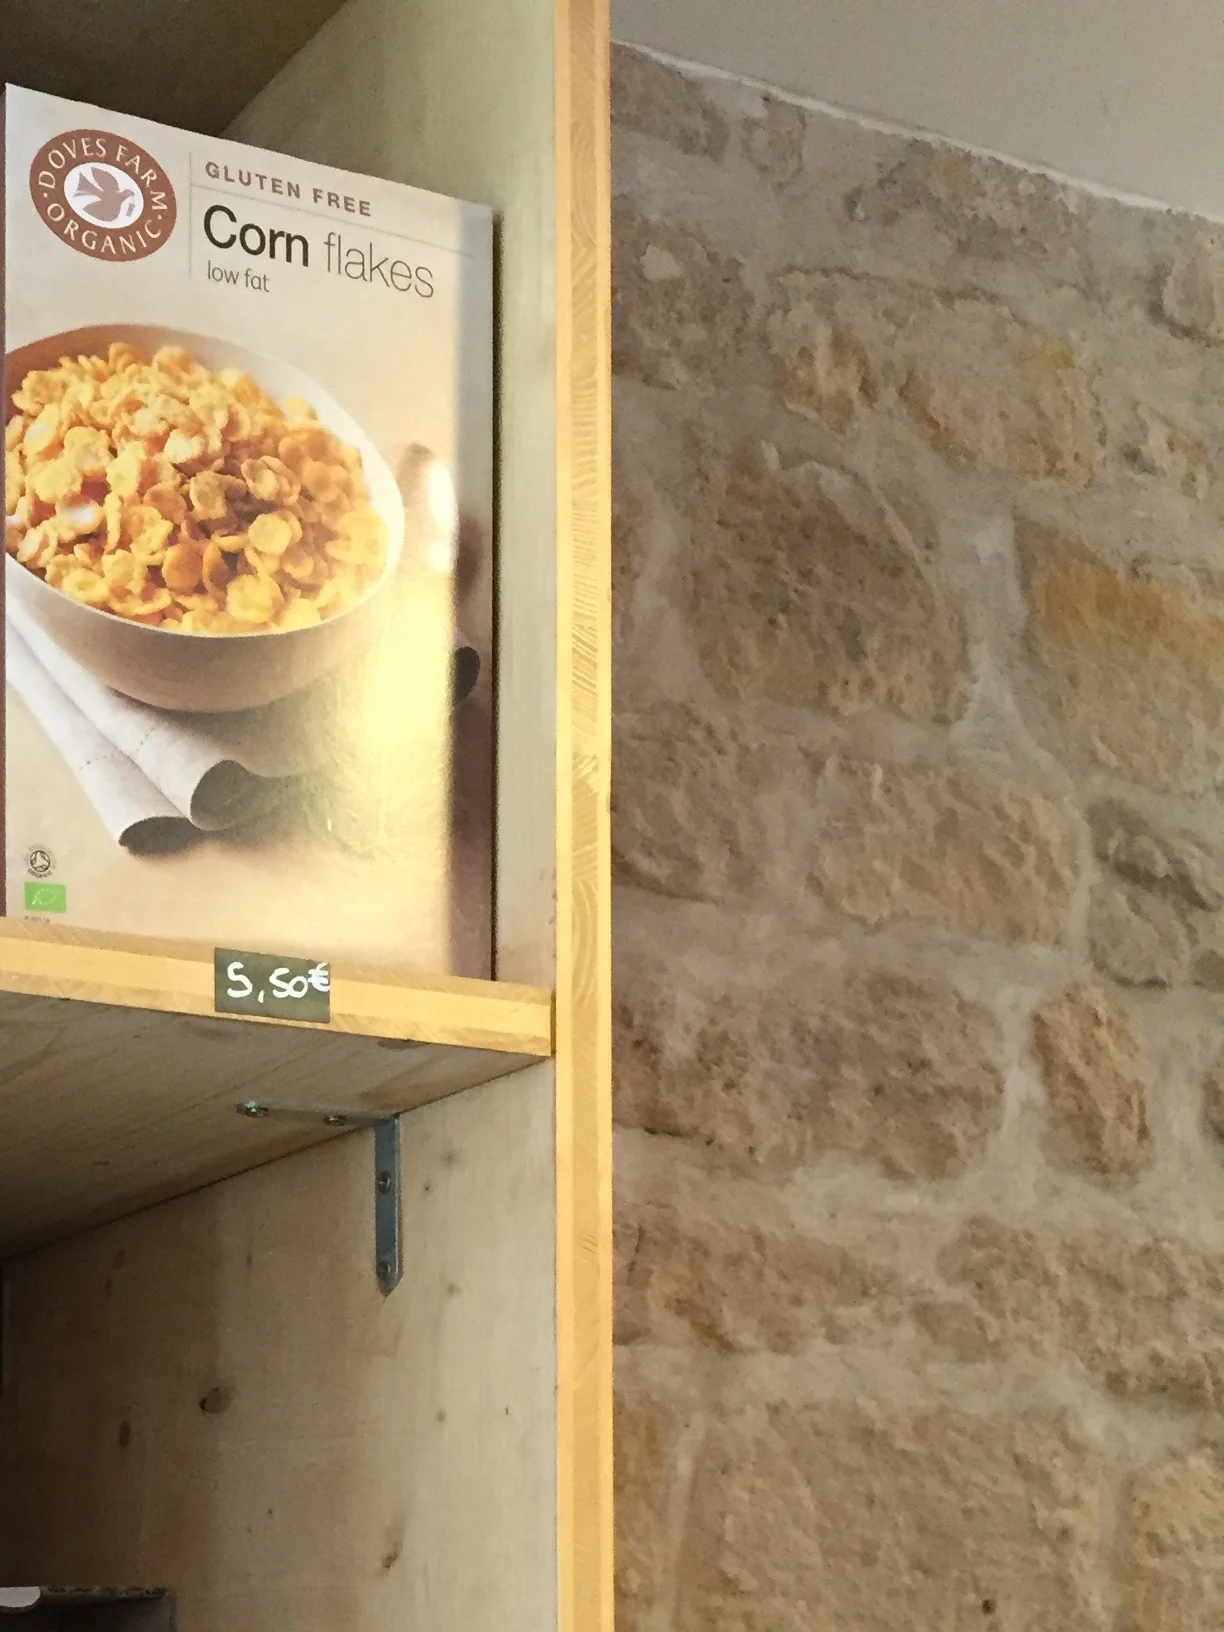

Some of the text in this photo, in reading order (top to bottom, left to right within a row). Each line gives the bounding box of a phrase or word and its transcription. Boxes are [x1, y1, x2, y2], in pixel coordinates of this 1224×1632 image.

[38, 136, 168, 211] DOVES FARM
[205, 161, 373, 218] GLUTEN FREE
[46, 202, 162, 255] ORGANIC
[203, 203, 436, 300] Corn flakes
[206, 260, 271, 293] low fat
